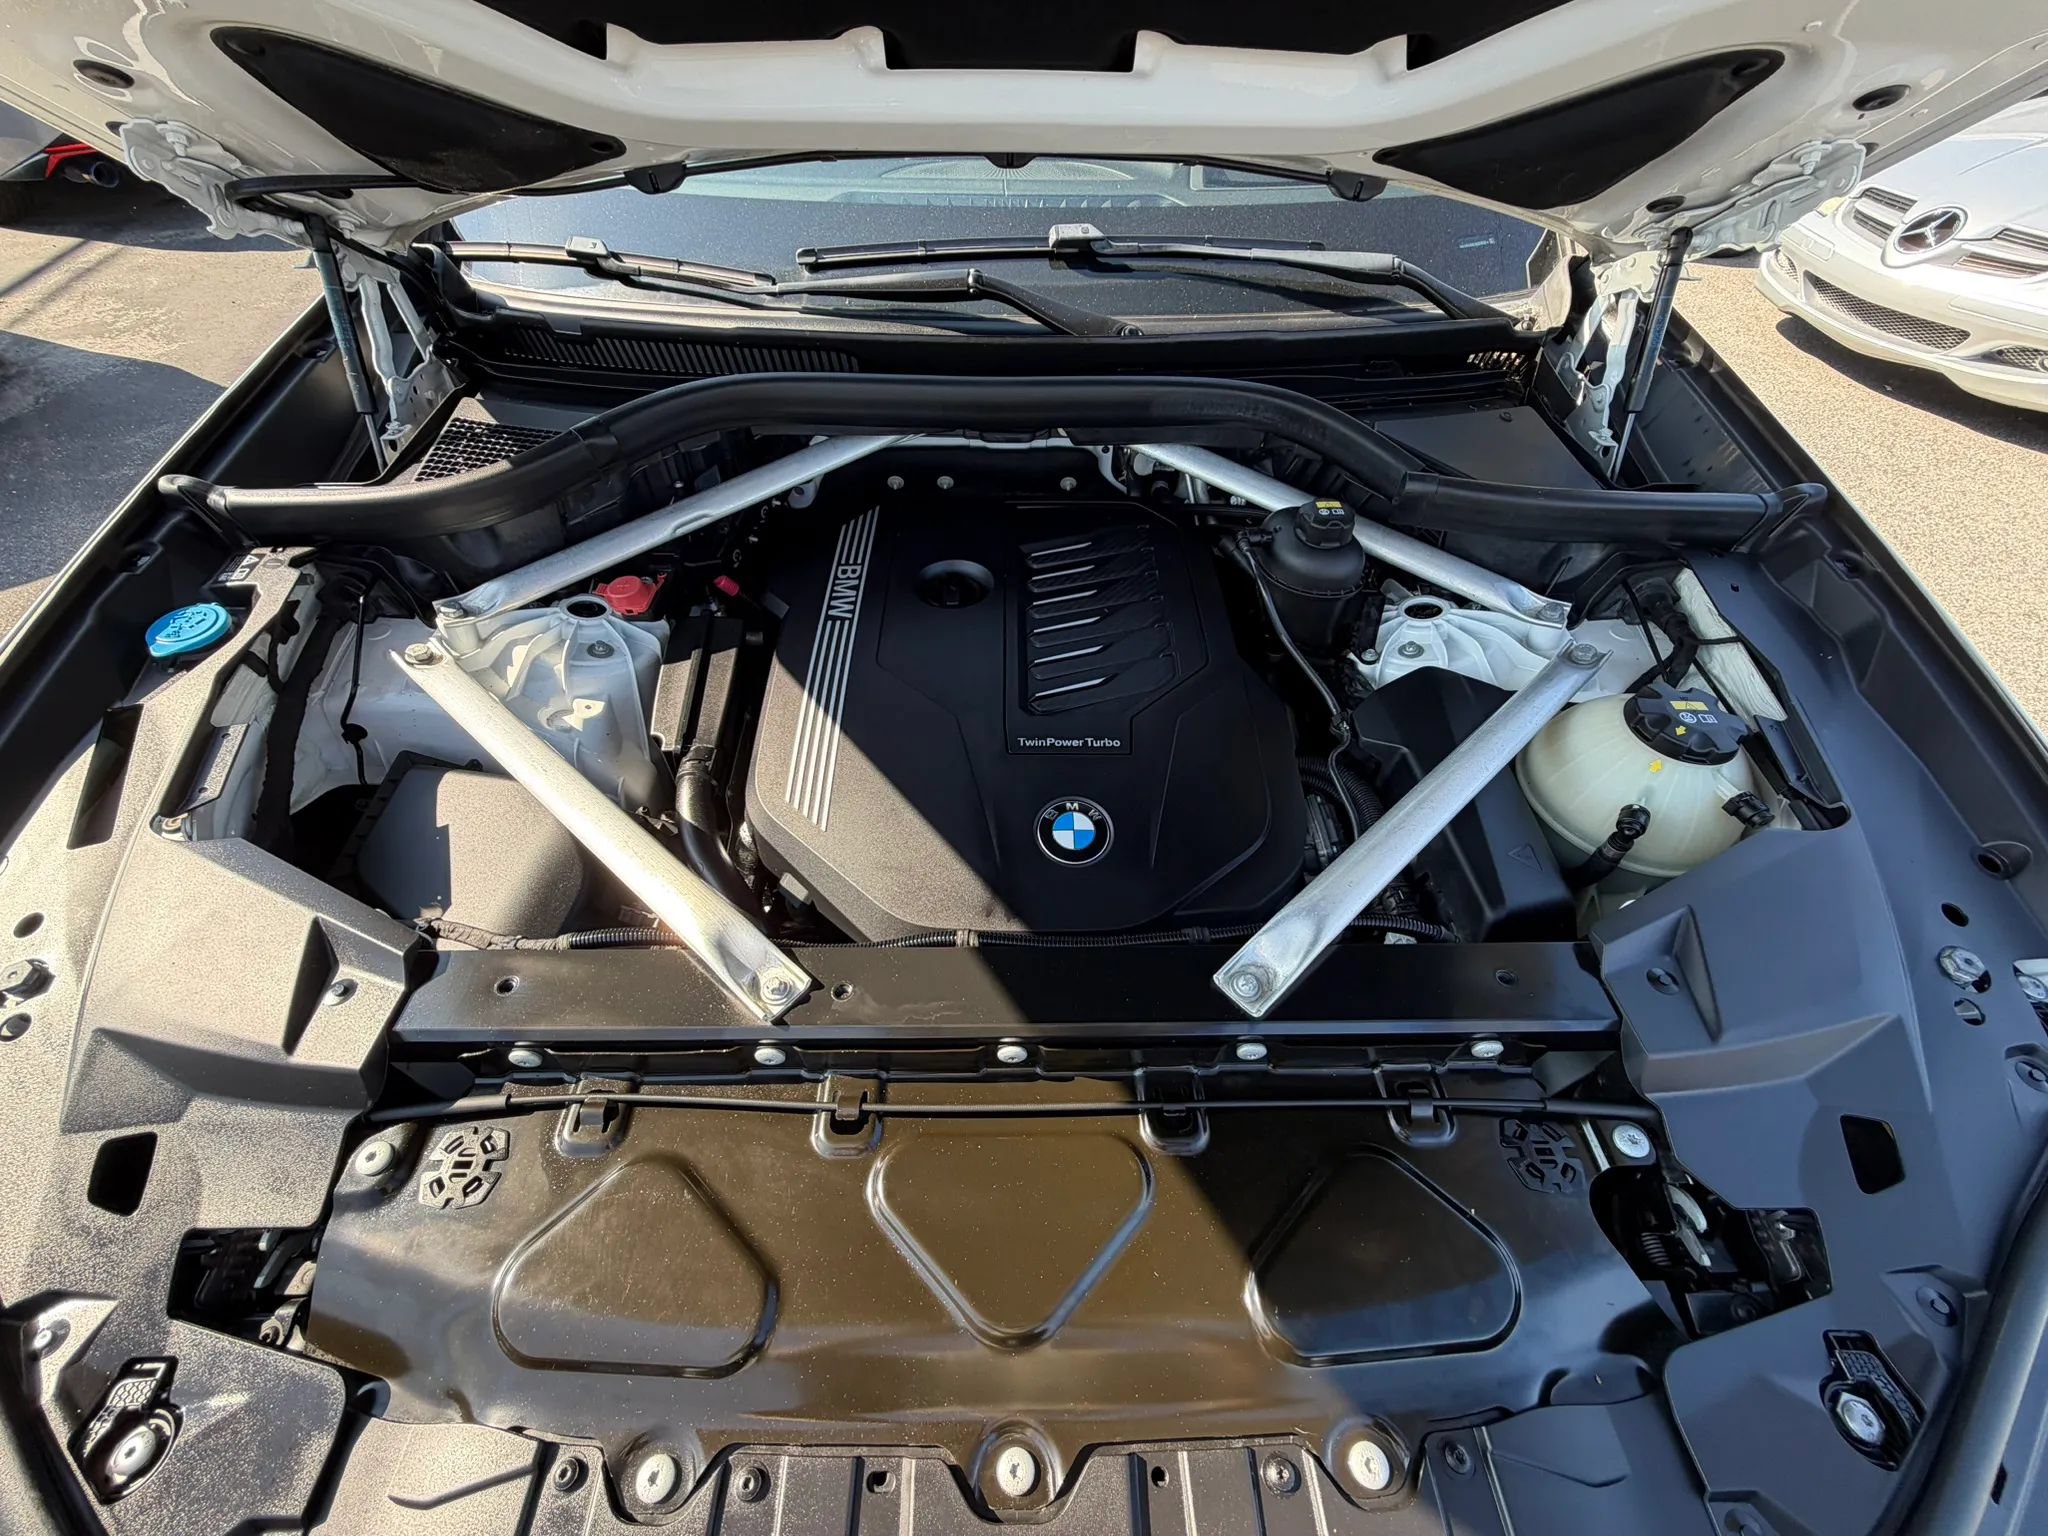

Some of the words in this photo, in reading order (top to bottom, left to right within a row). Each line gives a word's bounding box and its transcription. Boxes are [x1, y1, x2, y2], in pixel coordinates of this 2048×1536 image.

[827, 564, 862, 618] BMW
[1017, 737, 1084, 748] TwinPower
[1085, 737, 1121, 748] Turbo
[1045, 802, 1102, 821] BMW
